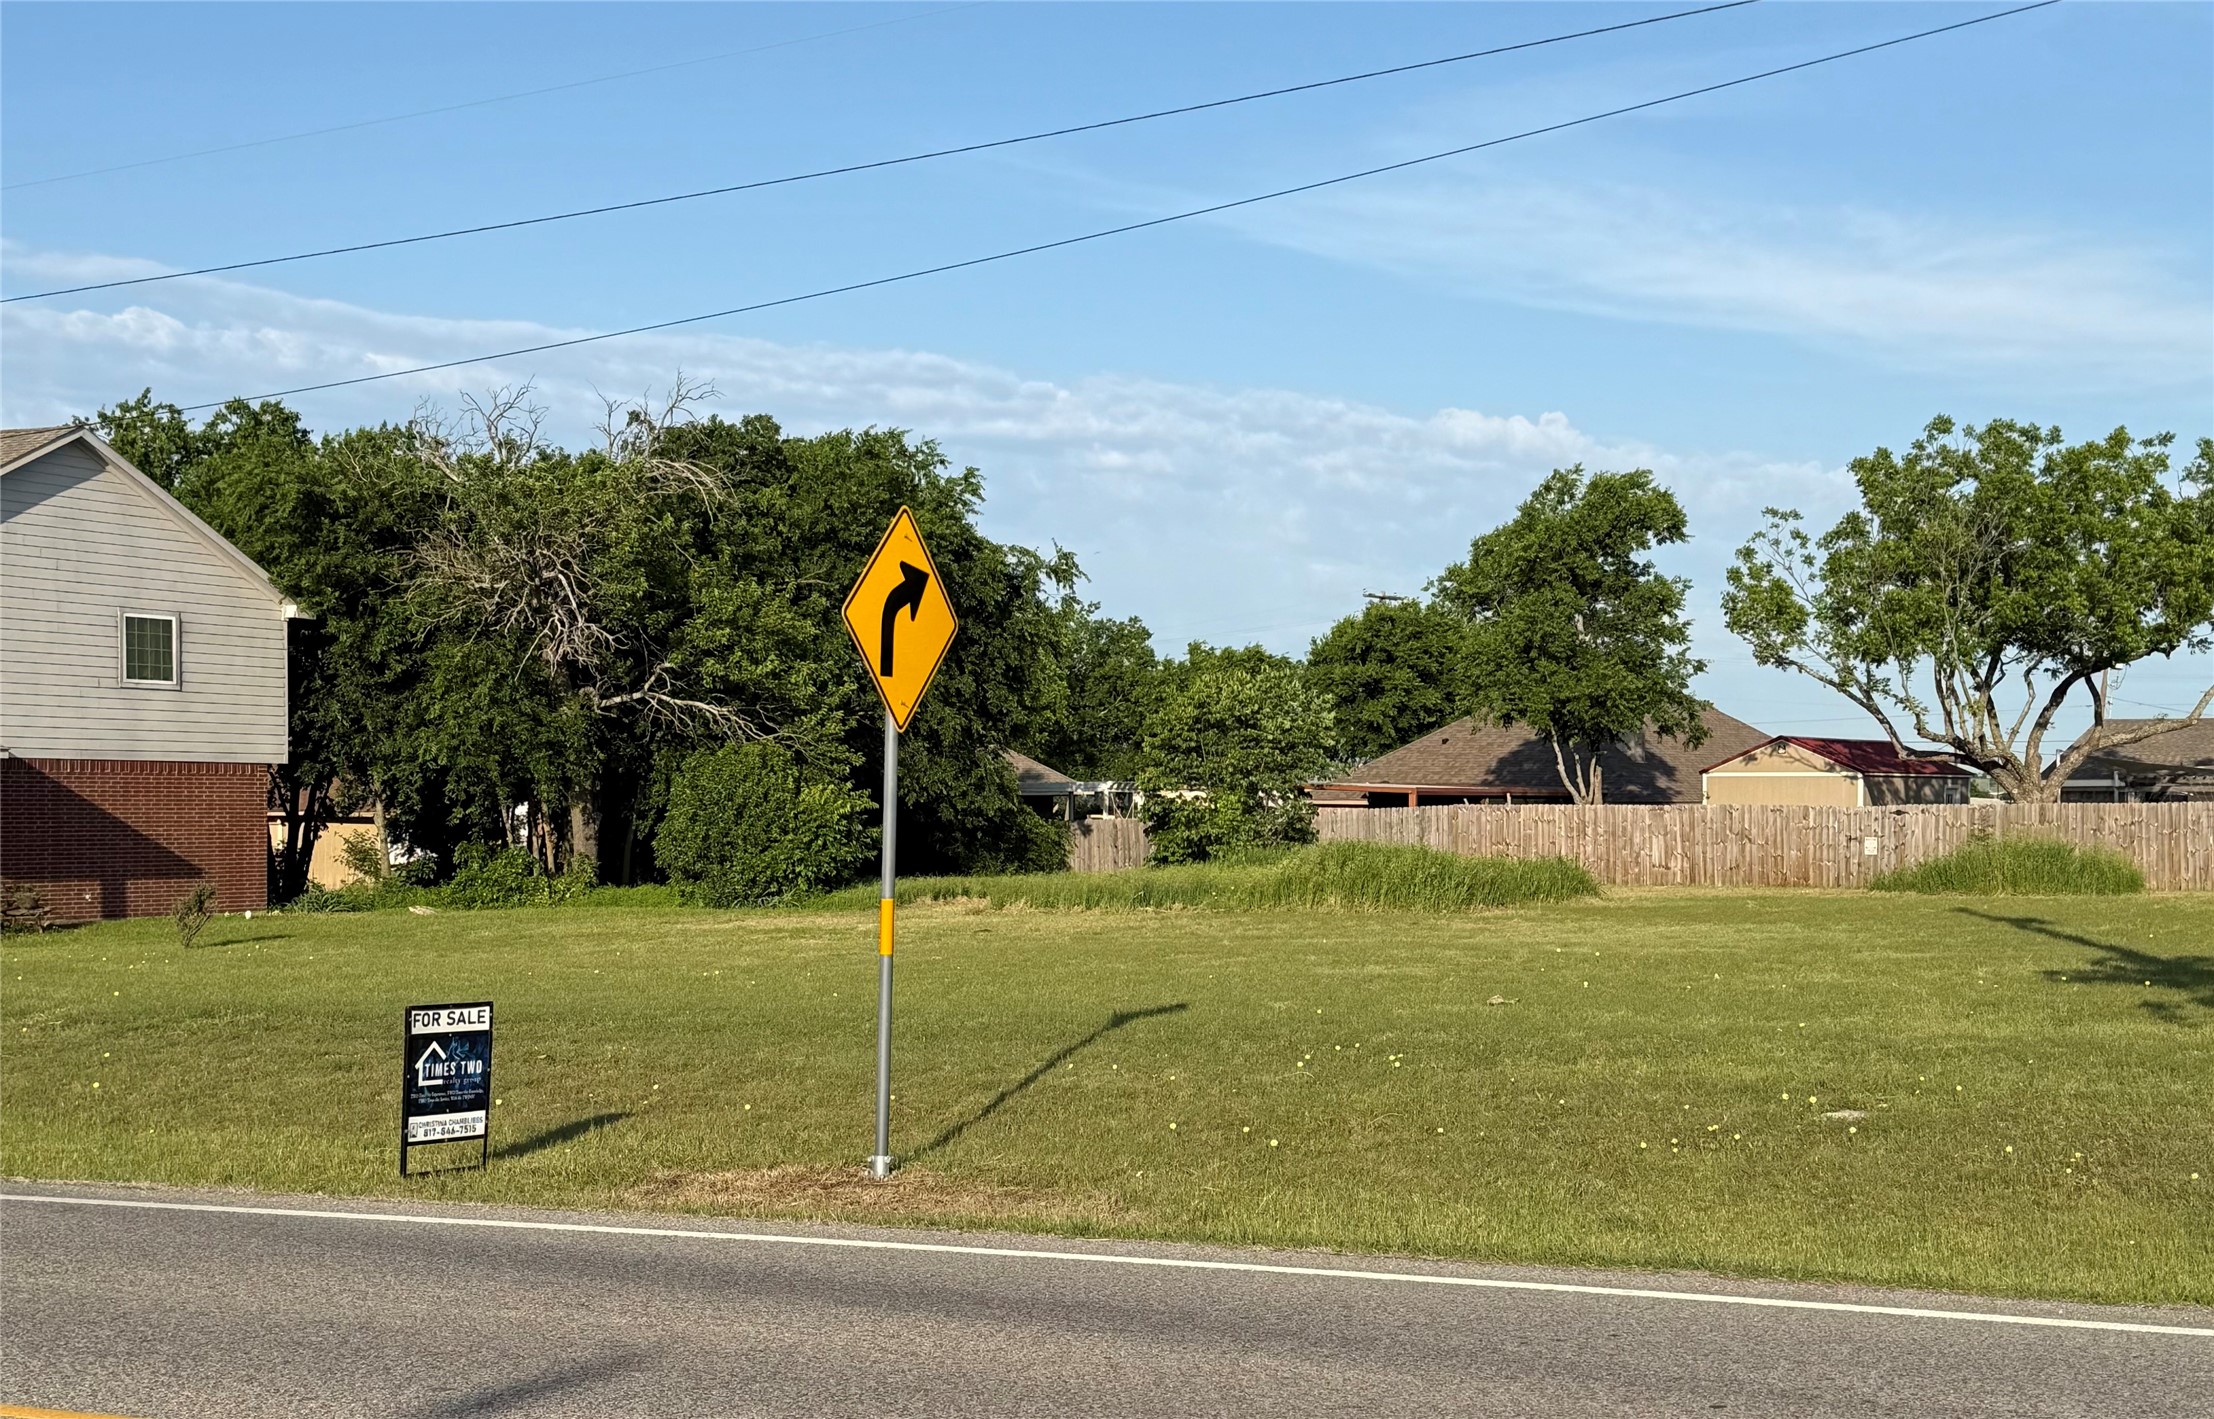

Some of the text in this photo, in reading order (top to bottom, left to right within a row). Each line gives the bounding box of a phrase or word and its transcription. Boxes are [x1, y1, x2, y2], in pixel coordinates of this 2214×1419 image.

[413, 1010, 486, 1028] FOR SALE
[424, 1060, 483, 1077] TIMES TWO
[418, 1119, 447, 1128] CHRISTINA
